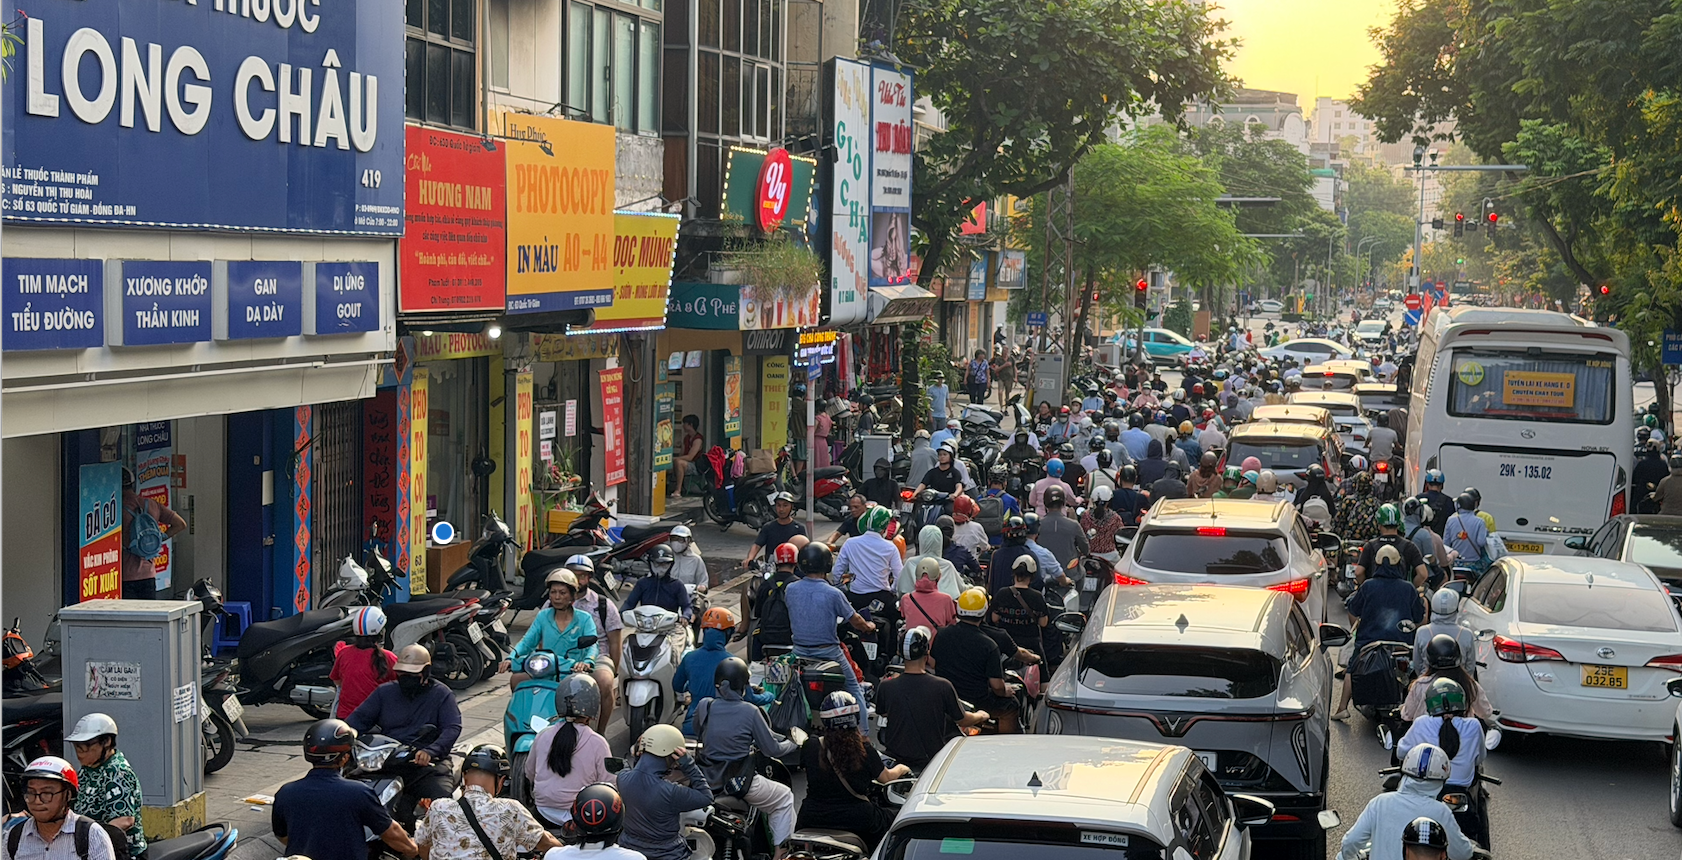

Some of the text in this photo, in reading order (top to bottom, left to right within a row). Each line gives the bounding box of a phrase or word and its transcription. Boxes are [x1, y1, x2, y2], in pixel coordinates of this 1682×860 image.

[26, 17, 378, 153] LONG CHÂU
[24, 166, 49, 181] THUỐC
[50, 169, 75, 183] THÀNH
[76, 170, 99, 186] PHẨM
[361, 169, 382, 188] 419
[766, 162, 787, 214] Vy
[45, 187, 57, 200] THỊ
[59, 187, 73, 199] THU
[75, 187, 93, 200] HOÀI
[419, 179, 492, 211] HƯƠNG NAM
[515, 164, 609, 215] PHOTOCOPY
[25, 201, 35, 212] 63
[37, 198, 58, 213] QUỐC
[517, 236, 559, 273] IN MÀU
[614, 235, 637, 275] DỌC
[18, 274, 88, 299] TIM MẠCH
[126, 273, 208, 297] XƯƠNG KHỚP
[254, 278, 277, 295] GAN
[333, 270, 365, 295] DỊ ỨNG
[12, 302, 95, 332] TIỂU ĐƯỜNG
[136, 302, 199, 329] THẦN KINH
[246, 301, 284, 326] DẠ DÀY
[336, 302, 362, 319] GOUT
[764, 383, 787, 392] THIẾT
[412, 388, 427, 421] PHO
[518, 392, 531, 420] PHO
[769, 401, 780, 413] BỊ
[770, 421, 778, 431] Y
[137, 435, 153, 446] LONG
[414, 431, 424, 462] TO
[520, 430, 529, 458] TO
[520, 467, 529, 496] CO
[1500, 463, 1516, 477] 29K
[1524, 465, 1552, 479] 135.02
[414, 473, 424, 504] CO
[86, 491, 116, 541] ĐÃ CÓ
[519, 503, 529, 533] PY
[414, 513, 424, 546] PY
[1562, 527, 1594, 535] LONG
[415, 554, 423, 567] 63
[83, 566, 119, 598] SỐT XUẤT
[1586, 676, 1623, 687] 032.85
[1594, 665, 1614, 677] 29E
[1093, 834, 1107, 843] HỢP
[1108, 835, 1126, 844] ĐỒNG
